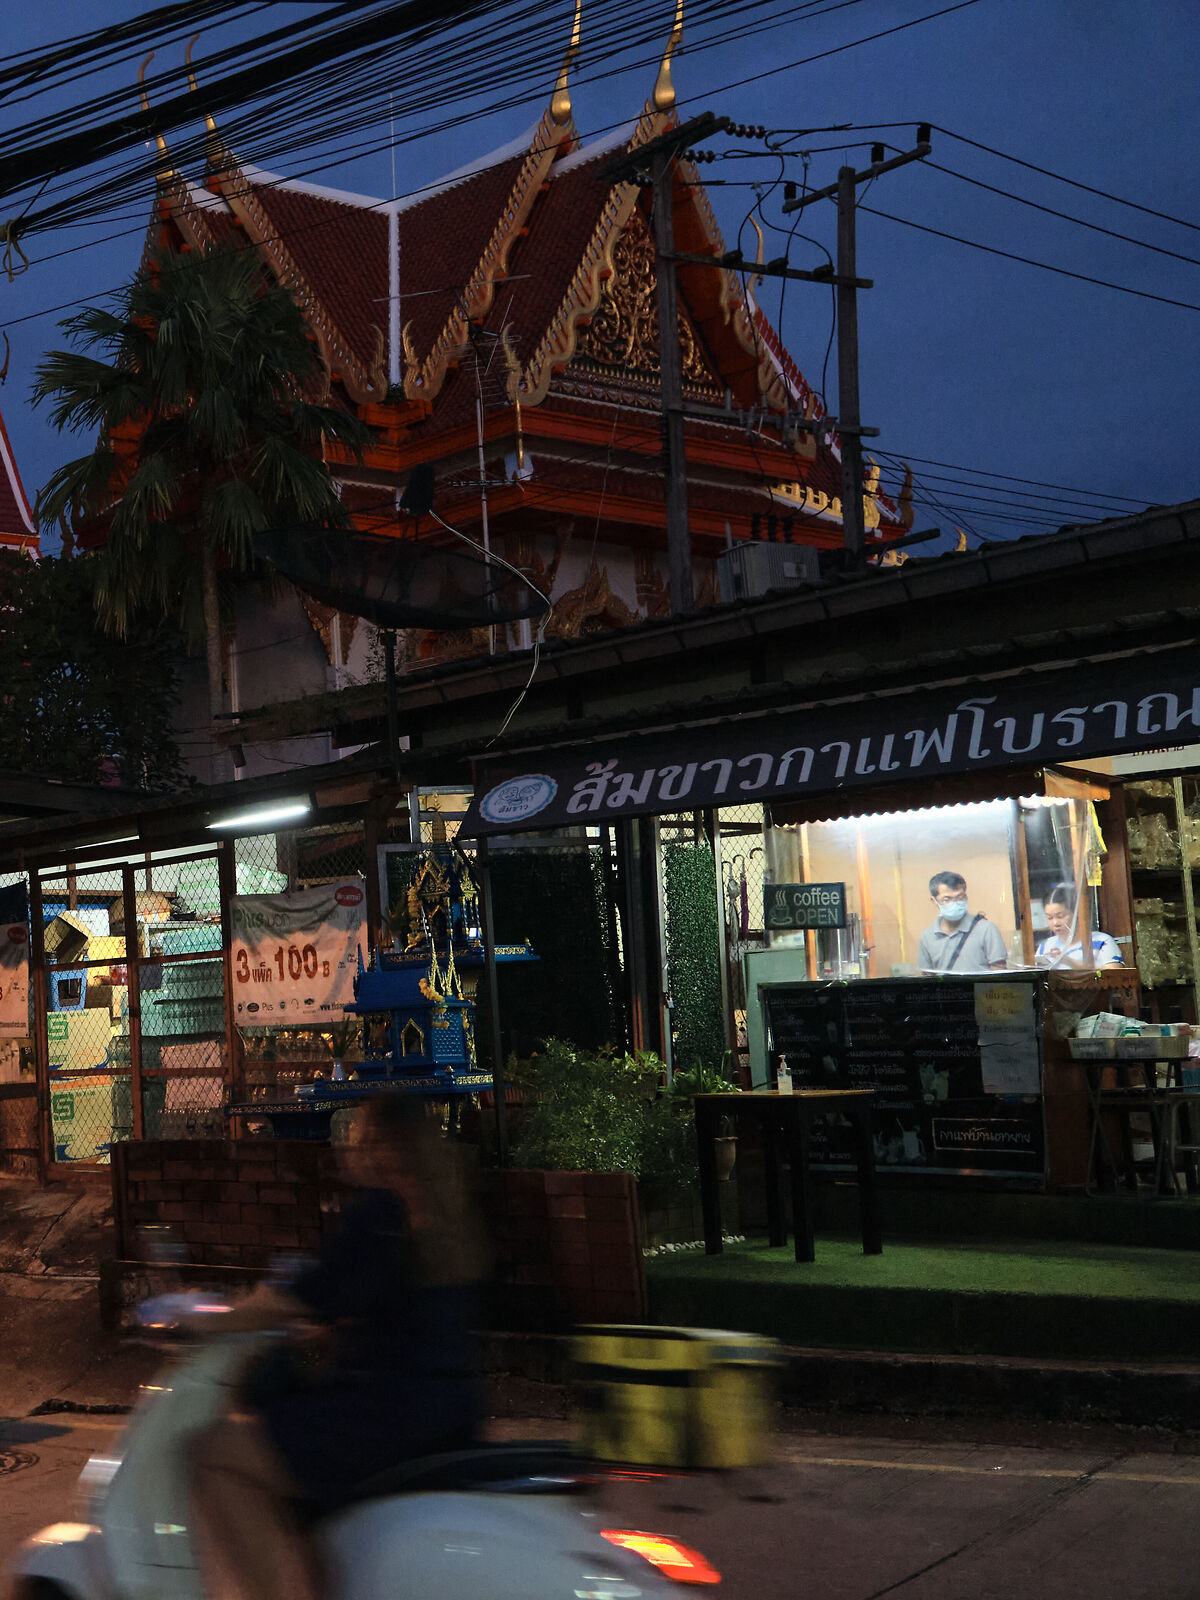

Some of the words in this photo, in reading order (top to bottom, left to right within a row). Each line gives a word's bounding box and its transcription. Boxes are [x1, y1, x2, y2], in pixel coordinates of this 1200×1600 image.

[566, 687, 1200, 814] ส้มขาวกาแฟโบราณ
[793, 887, 840, 906] coffee
[795, 907, 838, 926] OPEN
[236, 948, 250, 984] 3
[274, 943, 318, 982] 100
